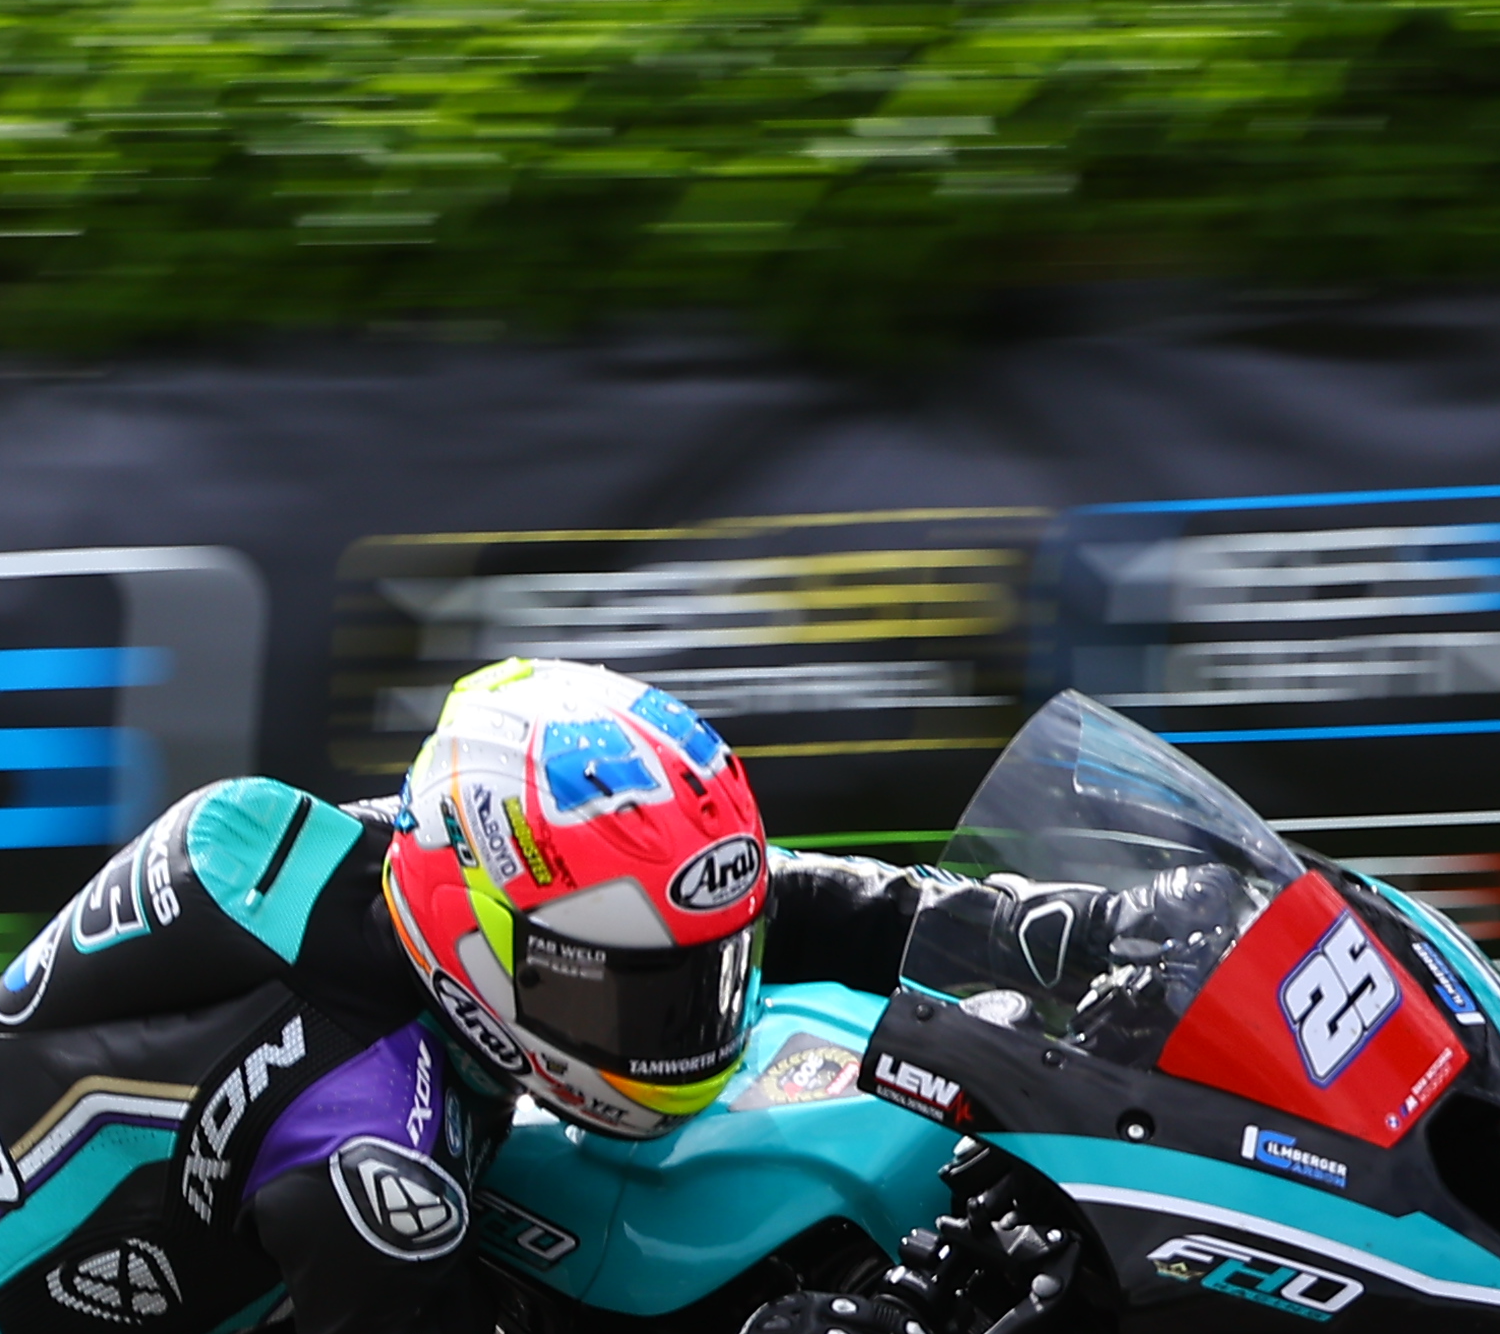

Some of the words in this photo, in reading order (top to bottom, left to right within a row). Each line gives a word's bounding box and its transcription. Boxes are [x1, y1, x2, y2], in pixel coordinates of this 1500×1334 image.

[1280, 910, 1402, 1085] 25
[182, 1015, 306, 1225] IXON
[407, 1039, 432, 1148] IXON
[875, 1052, 960, 1107] LEW
